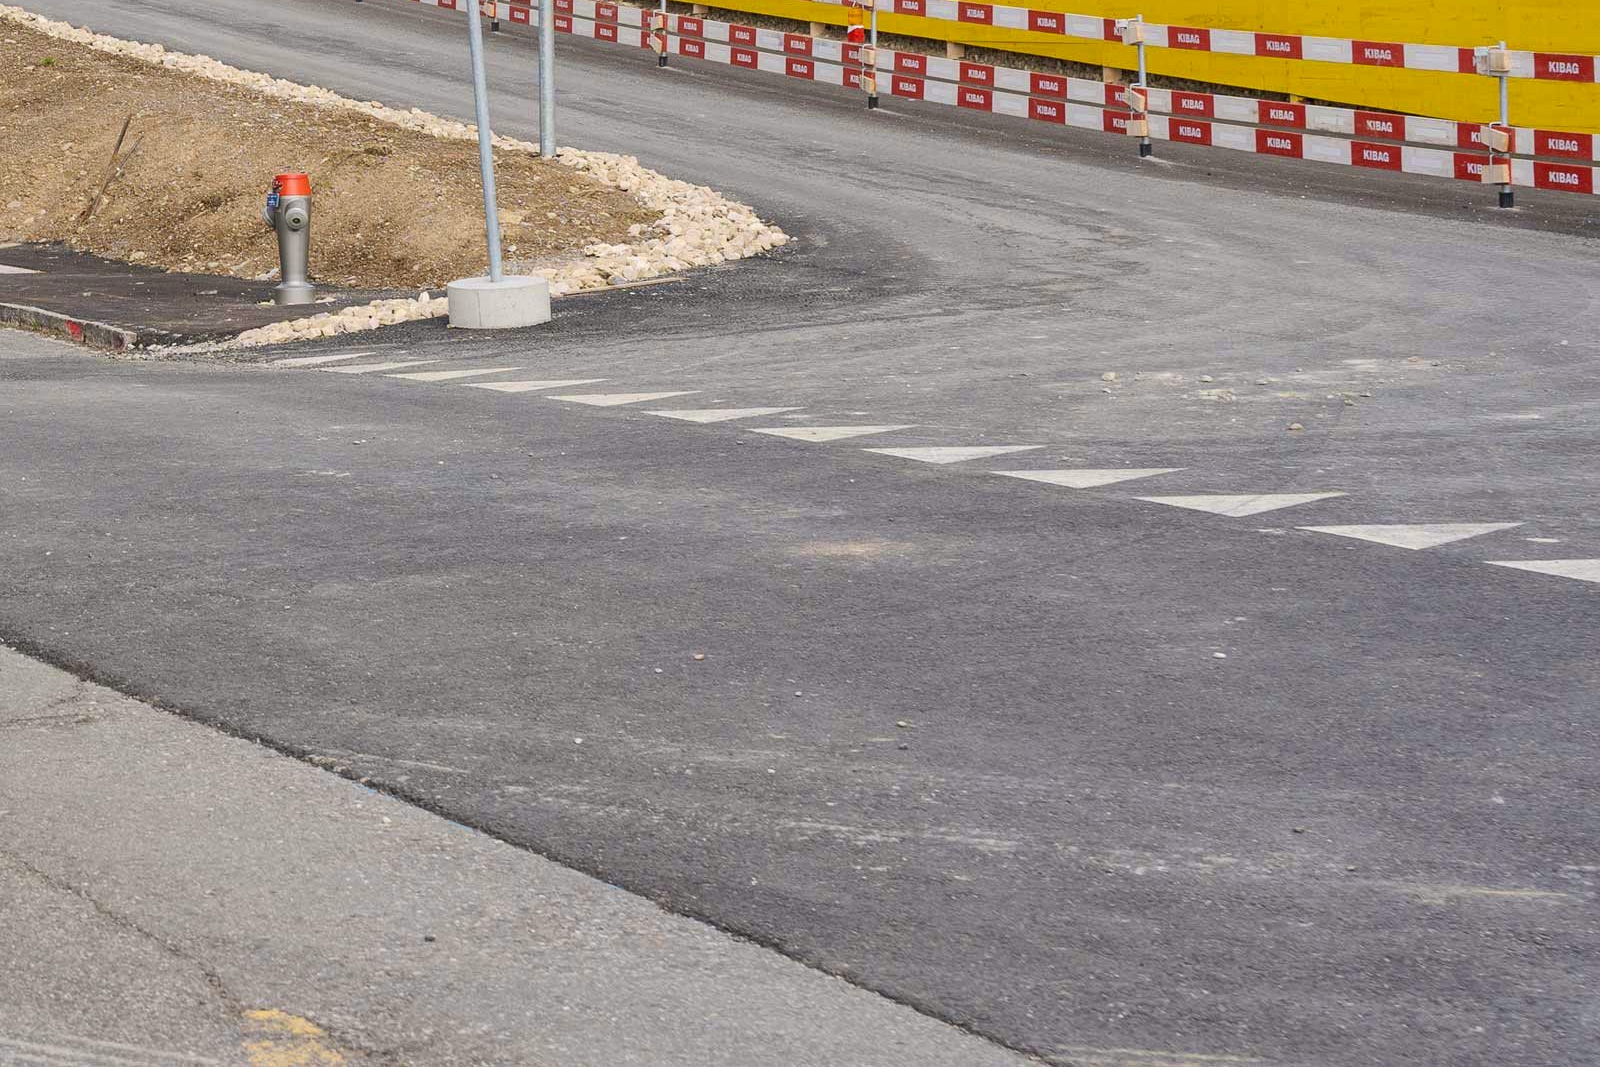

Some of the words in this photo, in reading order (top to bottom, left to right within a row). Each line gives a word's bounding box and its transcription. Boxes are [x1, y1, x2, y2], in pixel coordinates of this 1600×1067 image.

[902, 0, 919, 11] KIBAG
[967, 9, 985, 19] KIBAG
[1037, 18, 1057, 28] KIBAG
[1177, 33, 1200, 44] KIBAG
[1266, 41, 1291, 52] KIBAG
[1364, 48, 1392, 60] KIBAG
[902, 58, 920, 69] KIBAG
[1548, 61, 1579, 75] KIBAG
[967, 69, 987, 80] KIBAG
[899, 82, 917, 92] KIBAG
[1038, 80, 1059, 92] KIBAG
[965, 92, 985, 104] KIBAG
[1181, 99, 1204, 110] KIBAG
[1036, 105, 1057, 117] KIBAG
[1269, 108, 1295, 121] KIBAG
[1178, 126, 1201, 138] KIBAG
[1366, 120, 1393, 133] KIBAG
[1266, 137, 1292, 149] KIBAG
[1548, 139, 1579, 152] KIBAG
[1363, 150, 1390, 162] KIBAG
[1467, 162, 1482, 174] KIB
[1548, 172, 1579, 185] KIBAG
